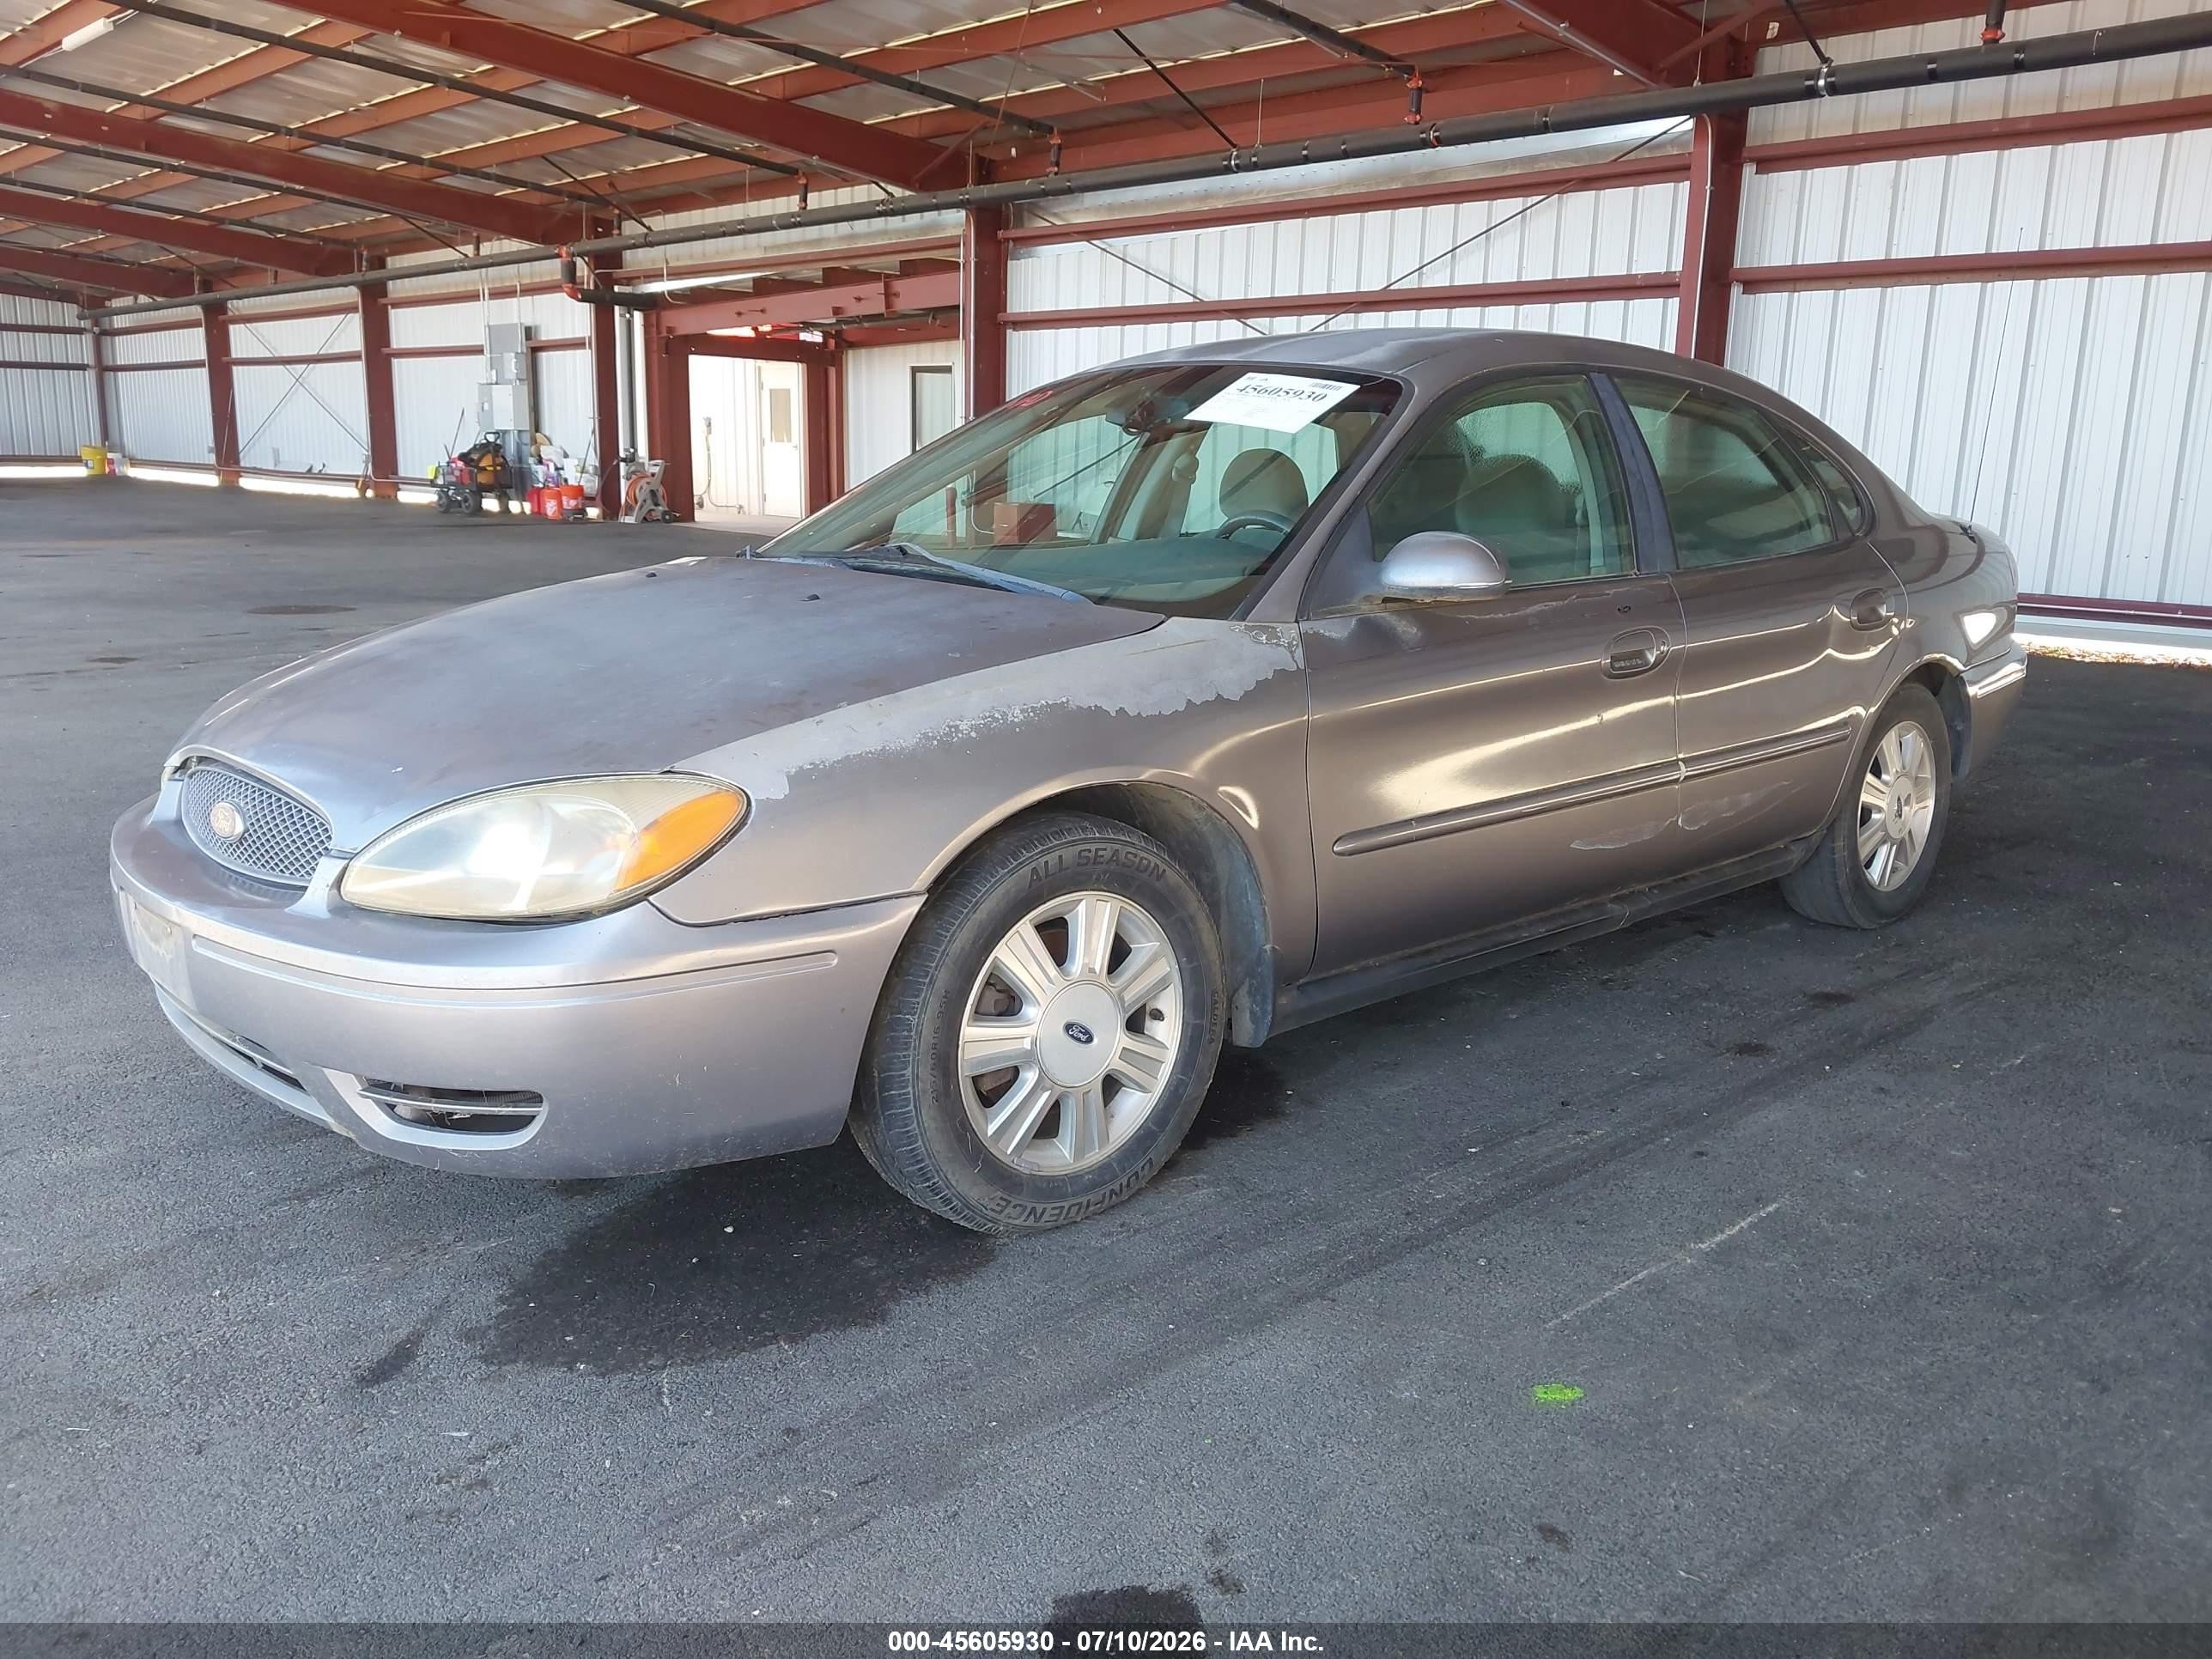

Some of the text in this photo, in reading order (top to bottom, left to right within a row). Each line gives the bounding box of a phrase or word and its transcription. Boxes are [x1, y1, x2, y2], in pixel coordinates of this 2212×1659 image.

[1237, 384, 1328, 403] 45605930
[1028, 847, 1167, 888] ALL SEASON
[1068, 1024, 1091, 1042] Ford
[989, 1157, 1155, 1224] CONFIDENCE
